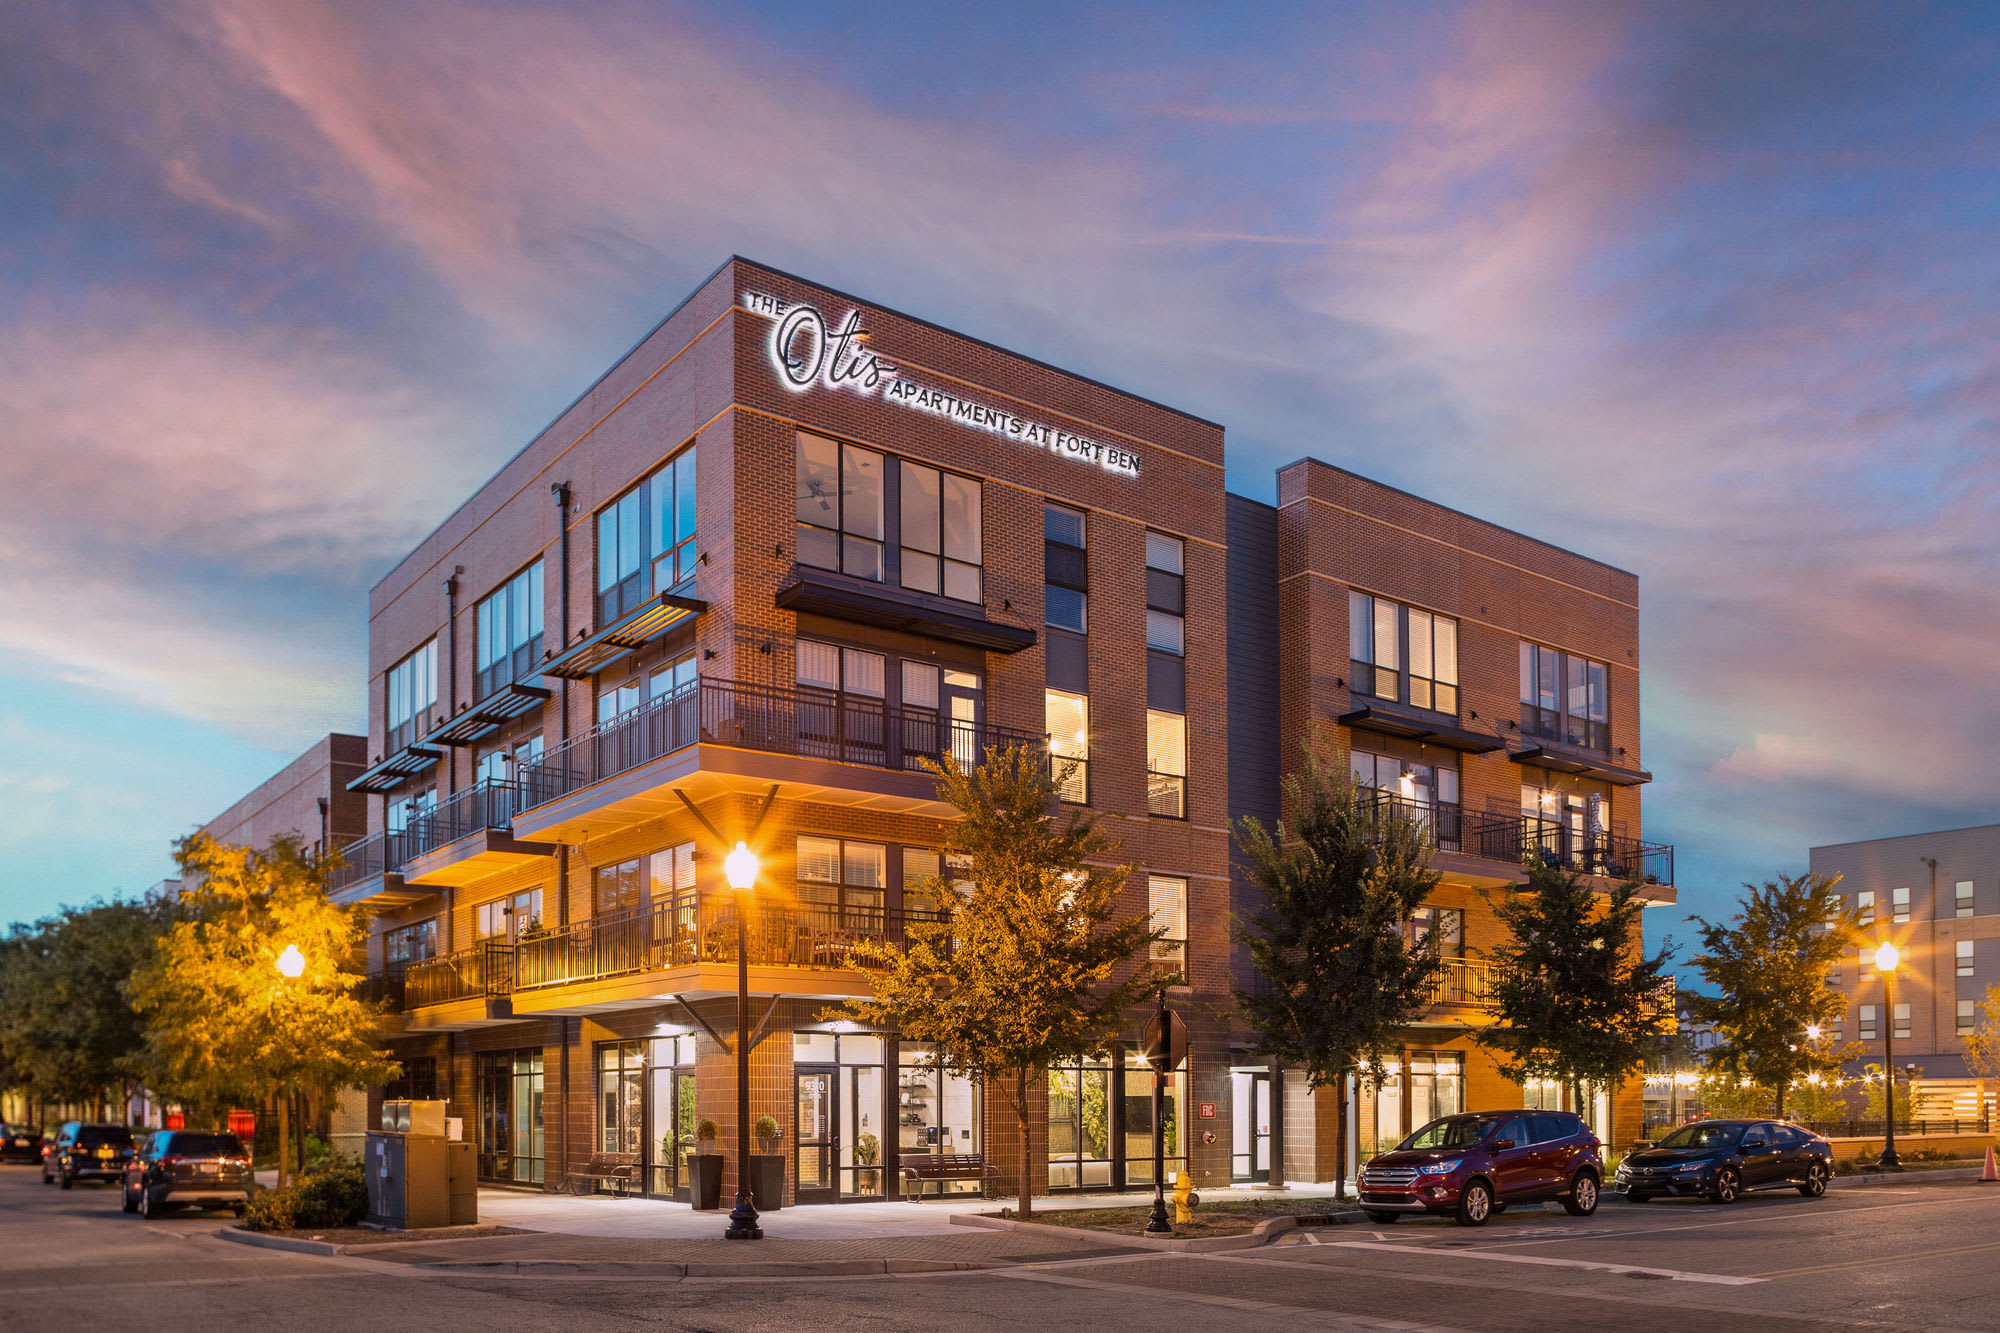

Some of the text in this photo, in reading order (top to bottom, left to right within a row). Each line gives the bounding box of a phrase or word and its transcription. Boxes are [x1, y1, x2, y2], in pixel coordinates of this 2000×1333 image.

[749, 292, 786, 315] THE
[776, 307, 897, 388] Otis
[890, 380, 1140, 473] APARTMENTS AT FORT BEN
[805, 1081, 825, 1091] 930
